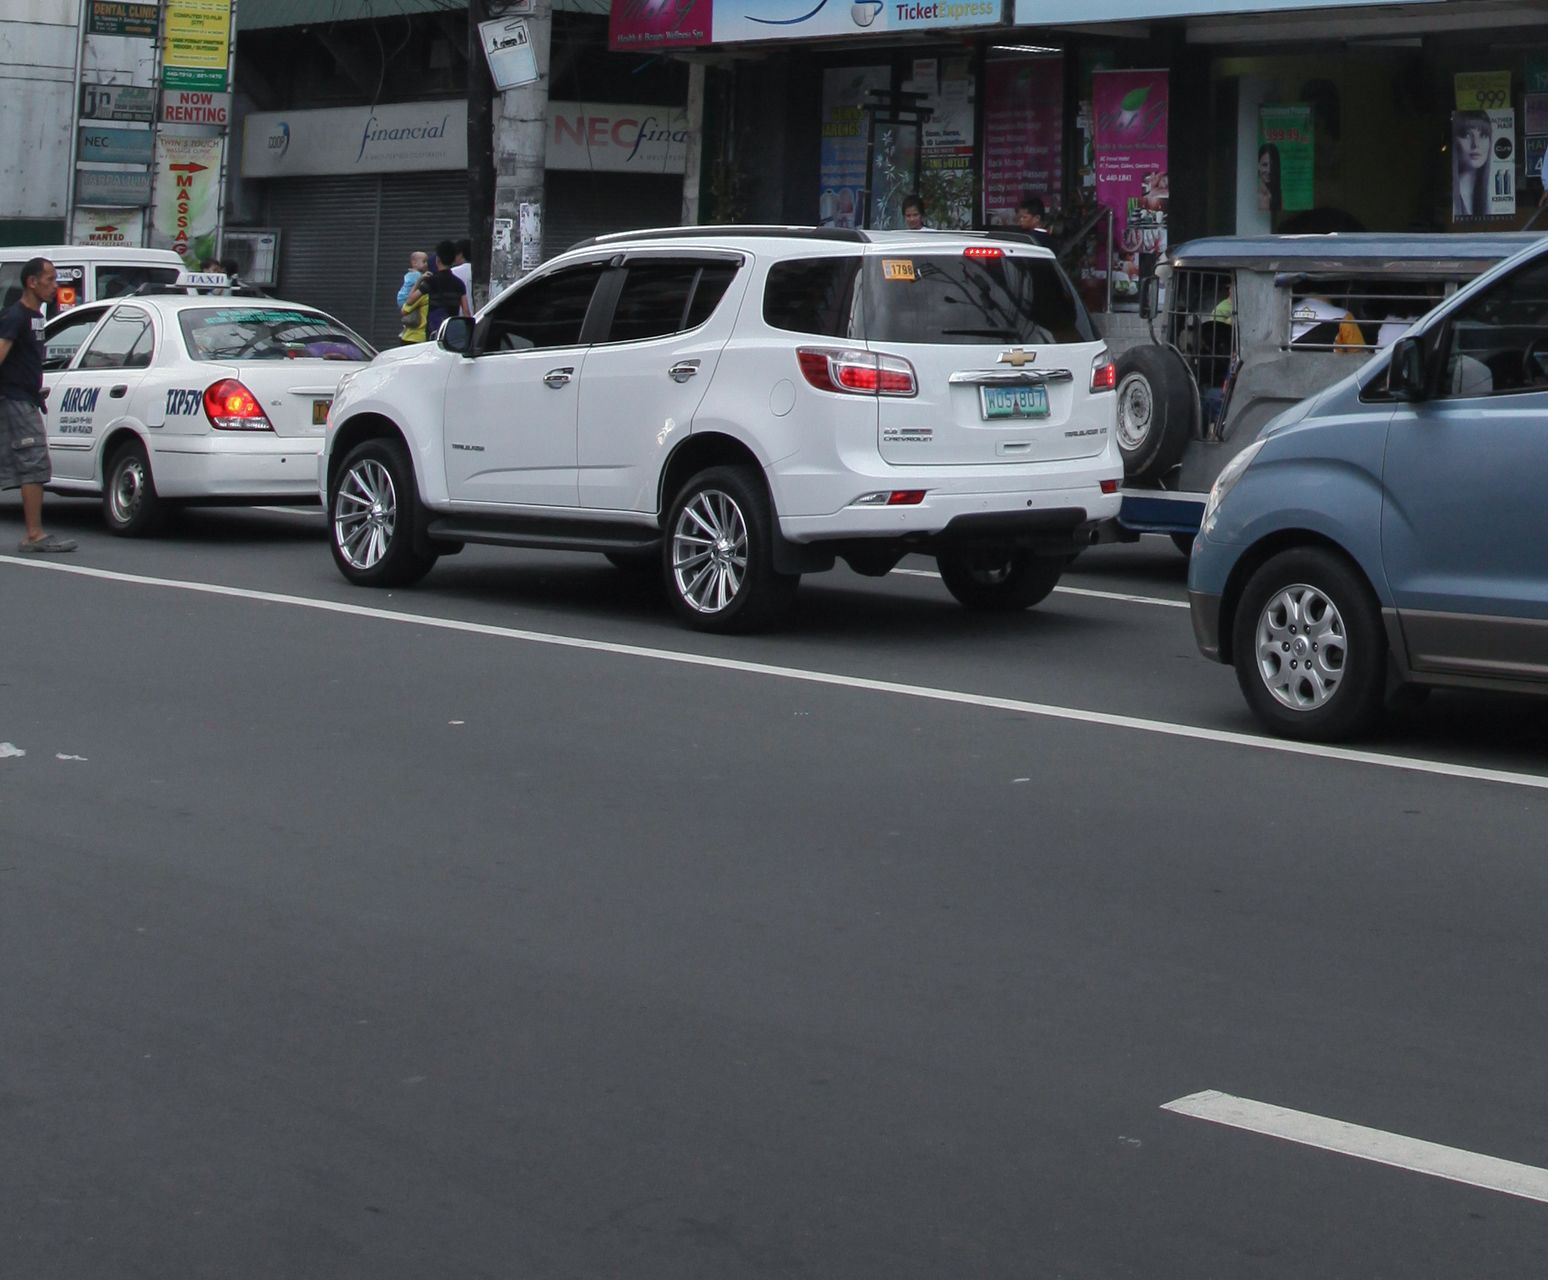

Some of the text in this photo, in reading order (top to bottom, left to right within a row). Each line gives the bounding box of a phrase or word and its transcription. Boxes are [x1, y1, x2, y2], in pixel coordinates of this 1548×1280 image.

[94, 2, 126, 17] DENTAL
[128, 4, 157, 18] CLINIC
[180, 93, 213, 105] NOW
[165, 106, 226, 122] RENTING
[84, 136, 109, 147] NEC
[355, 116, 449, 164] financial
[554, 115, 639, 148] NEC
[172, 175, 192, 255] MASSAG
[190, 274, 220, 284] TAXI
[60, 387, 101, 412] AIRCON
[166, 388, 203, 415] TXP579
[1019, 387, 1044, 407] 807
